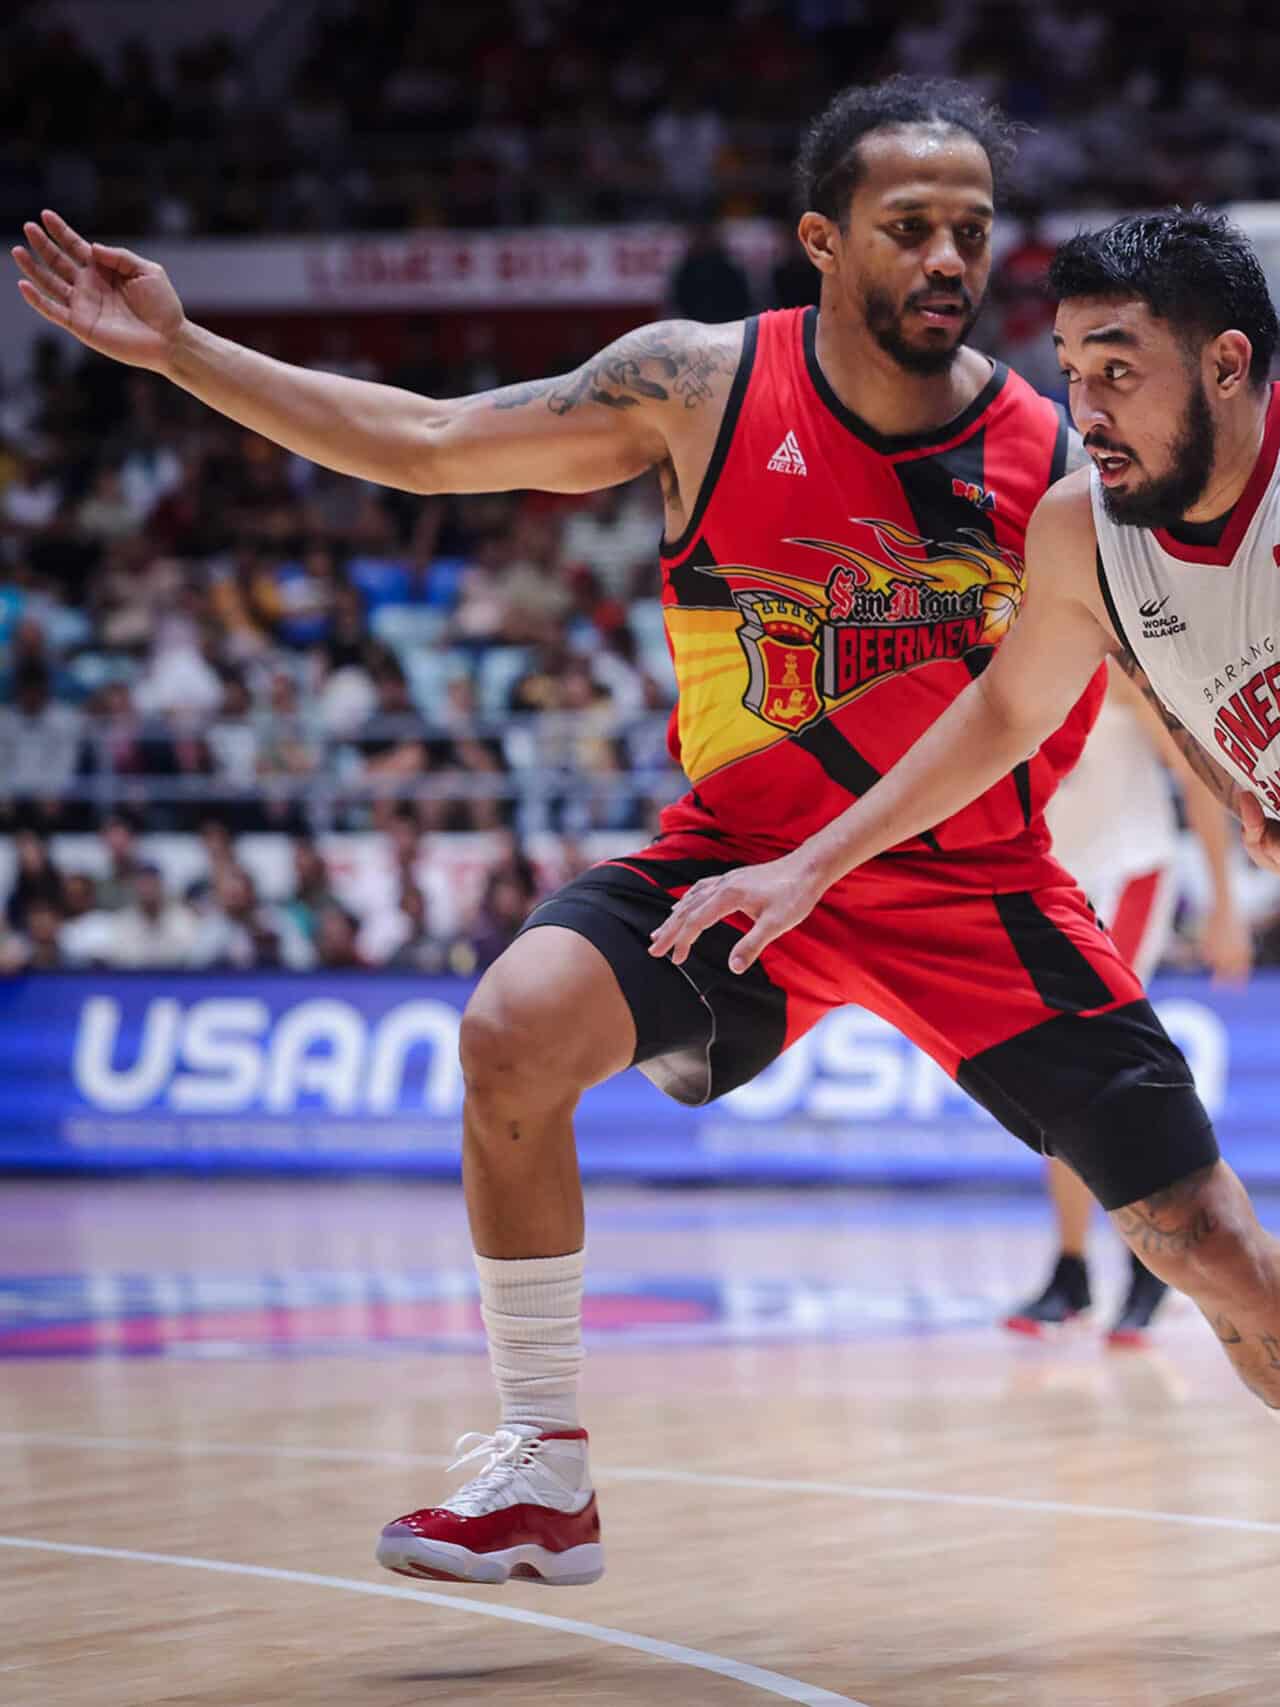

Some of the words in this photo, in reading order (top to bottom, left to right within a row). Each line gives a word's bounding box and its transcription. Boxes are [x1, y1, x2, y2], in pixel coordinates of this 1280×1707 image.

[767, 460, 807, 477] DELTA
[834, 567, 887, 621] San
[886, 582, 983, 622] Miguel
[1142, 622, 1187, 639] BALANCE
[1143, 615, 1179, 629] WORLD
[836, 614, 987, 694] BEERMEN
[72, 996, 463, 1114] USAN
